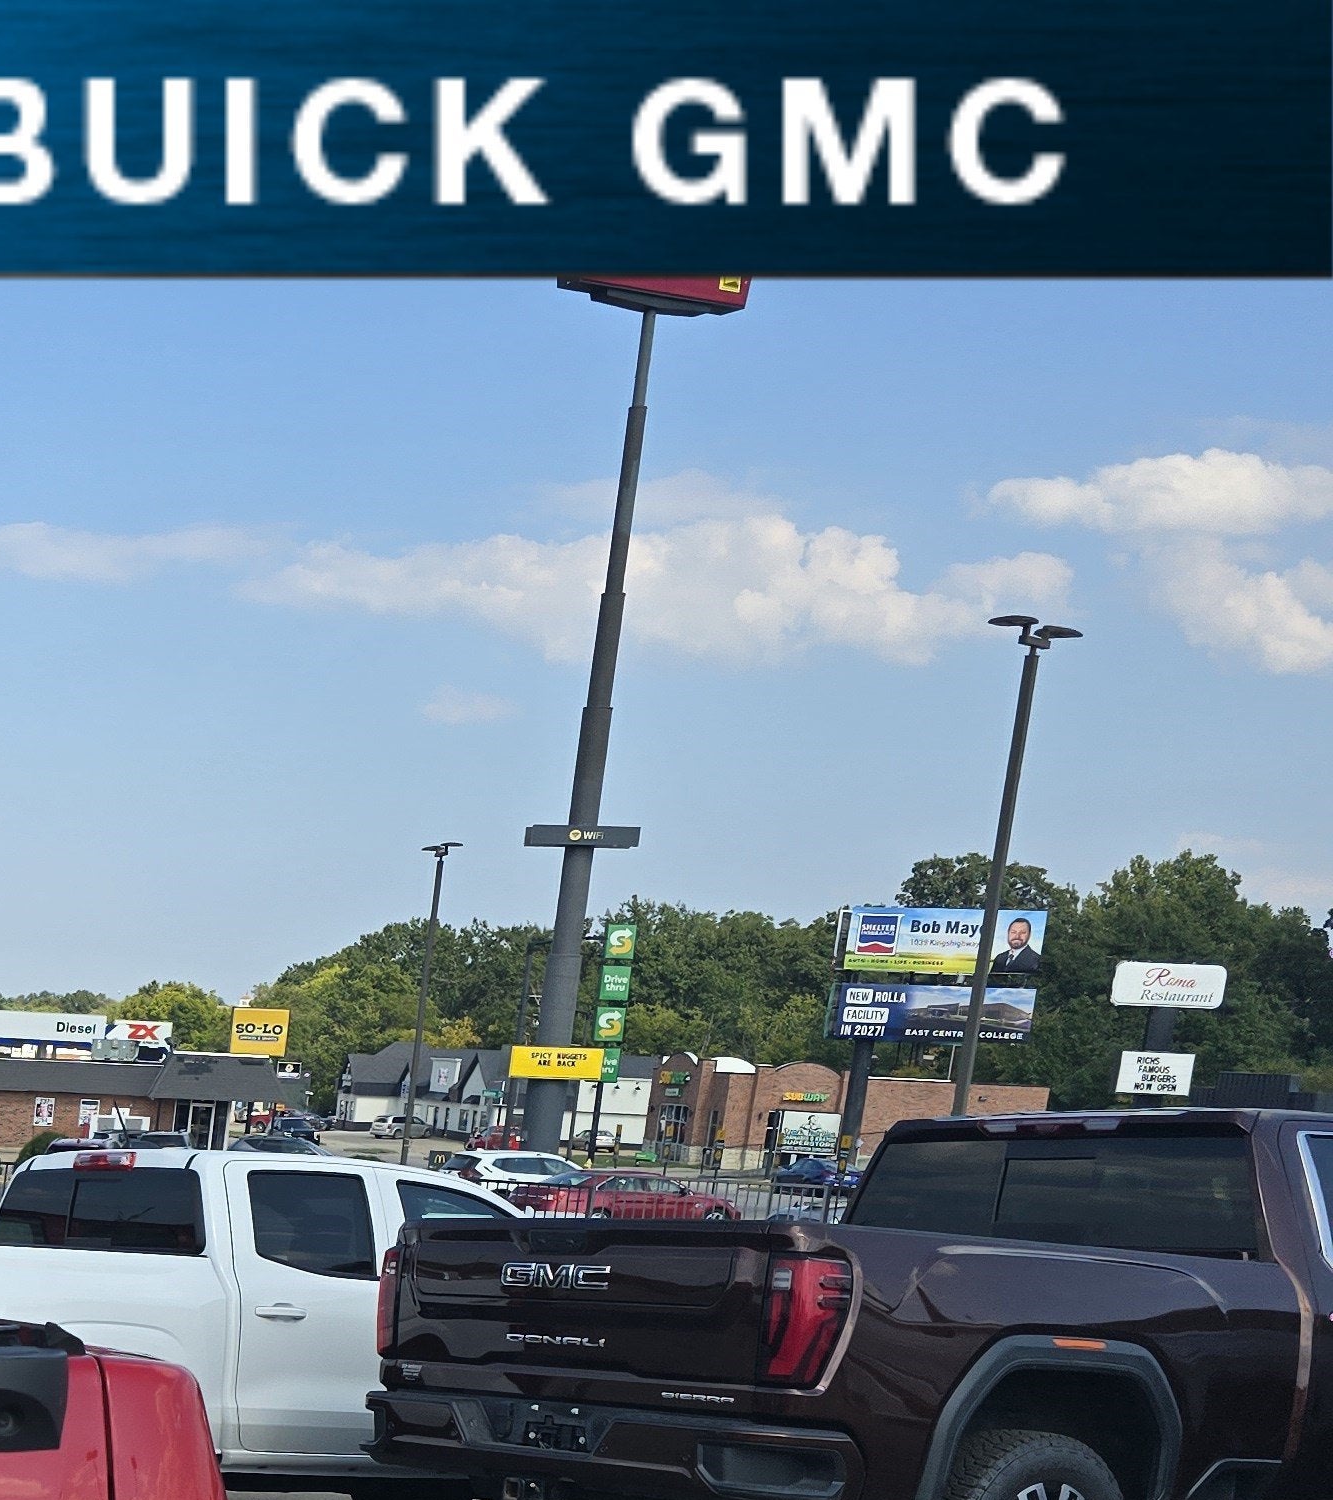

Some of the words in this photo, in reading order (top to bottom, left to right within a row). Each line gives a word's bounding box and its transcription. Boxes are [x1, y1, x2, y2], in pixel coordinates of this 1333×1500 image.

[861, 923, 895, 932] SHELTER
[910, 919, 942, 934] Bob
[945, 921, 983, 937] May
[604, 974, 628, 984] Drive
[605, 983, 626, 992] thru
[849, 992, 870, 1001] NEW
[874, 991, 906, 1003] ROLLA
[1140, 989, 1214, 1003] Restaurant
[846, 1010, 884, 1020] FACILITY
[56, 1021, 96, 1034] Diesel
[128, 1023, 161, 1040] ZX
[235, 1023, 283, 1035] SO-LO
[840, 1024, 852, 1036] IN
[904, 1028, 929, 1037] EAST
[932, 1029, 964, 1038] CENTR
[978, 1031, 1024, 1040] COLLEGE
[557, 1053, 587, 1061] NUGGETS
[1137, 1056, 1160, 1065] RICHS
[1138, 1065, 1170, 1074] FAMOUS
[1141, 1074, 1177, 1083] BURGERS
[1134, 1082, 1153, 1091] NOW
[1157, 1083, 1177, 1092] OPEN
[783, 1092, 830, 1102] SUBWAY
[501, 1262, 611, 1290] GMC
[506, 1333, 606, 1348] DENALI
[661, 1391, 734, 1404] SIERRA
